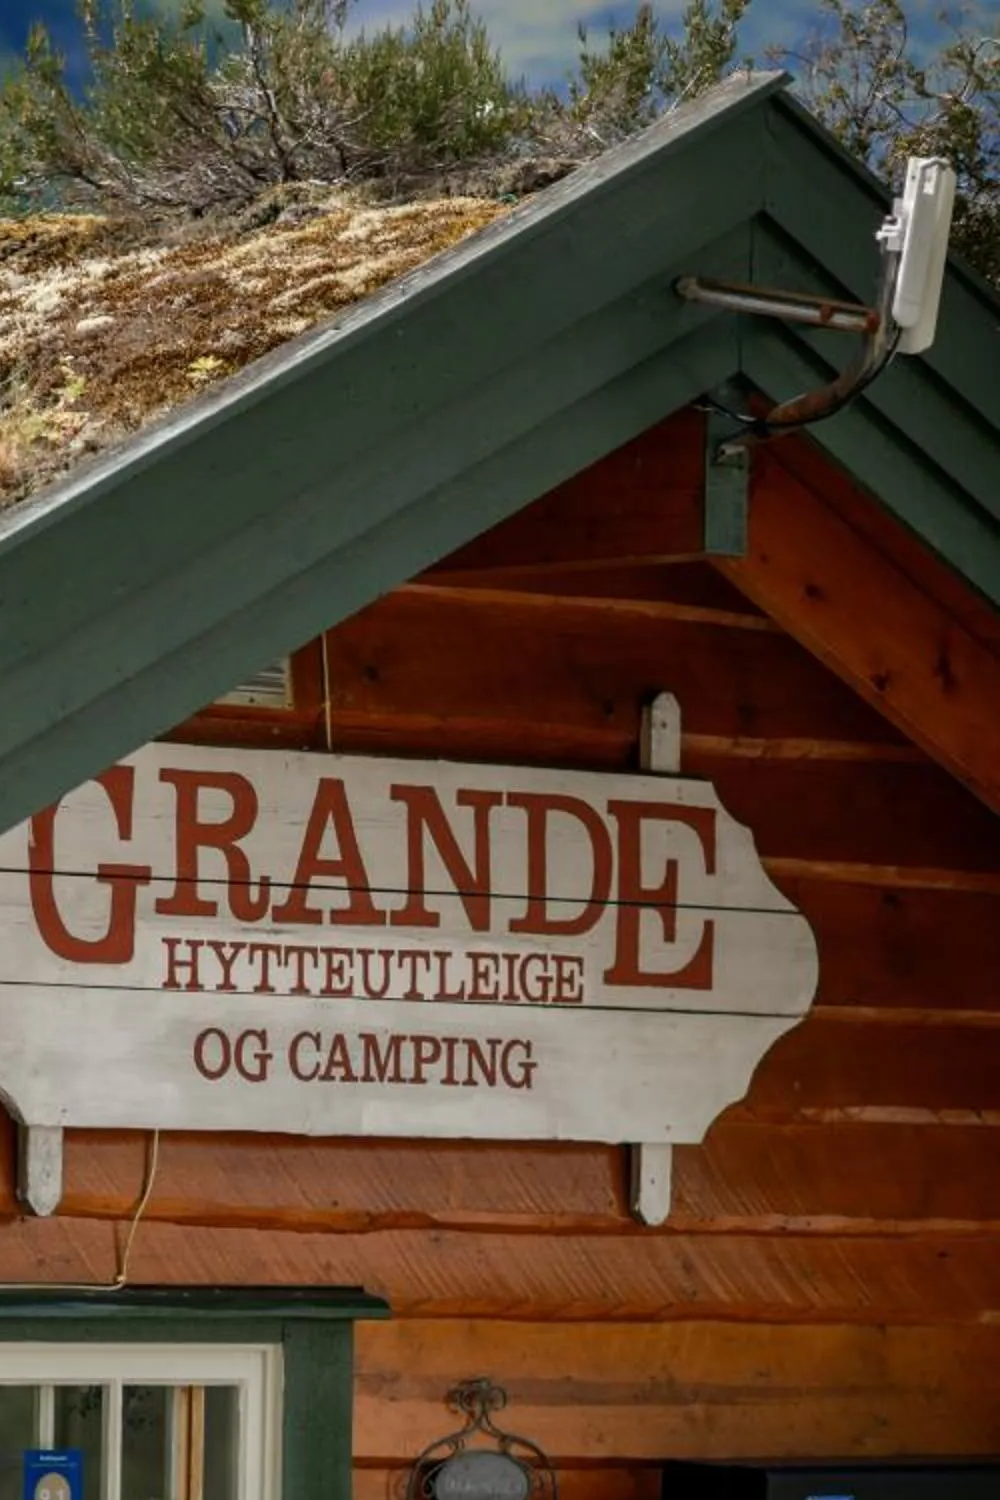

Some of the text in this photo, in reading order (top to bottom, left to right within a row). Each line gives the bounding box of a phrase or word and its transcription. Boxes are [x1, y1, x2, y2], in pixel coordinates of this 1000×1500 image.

[28, 766, 716, 990] GRANDE
[162, 937, 585, 1004] HYTTEUTLEIGE
[193, 1027, 538, 1089] OG CAMPING
